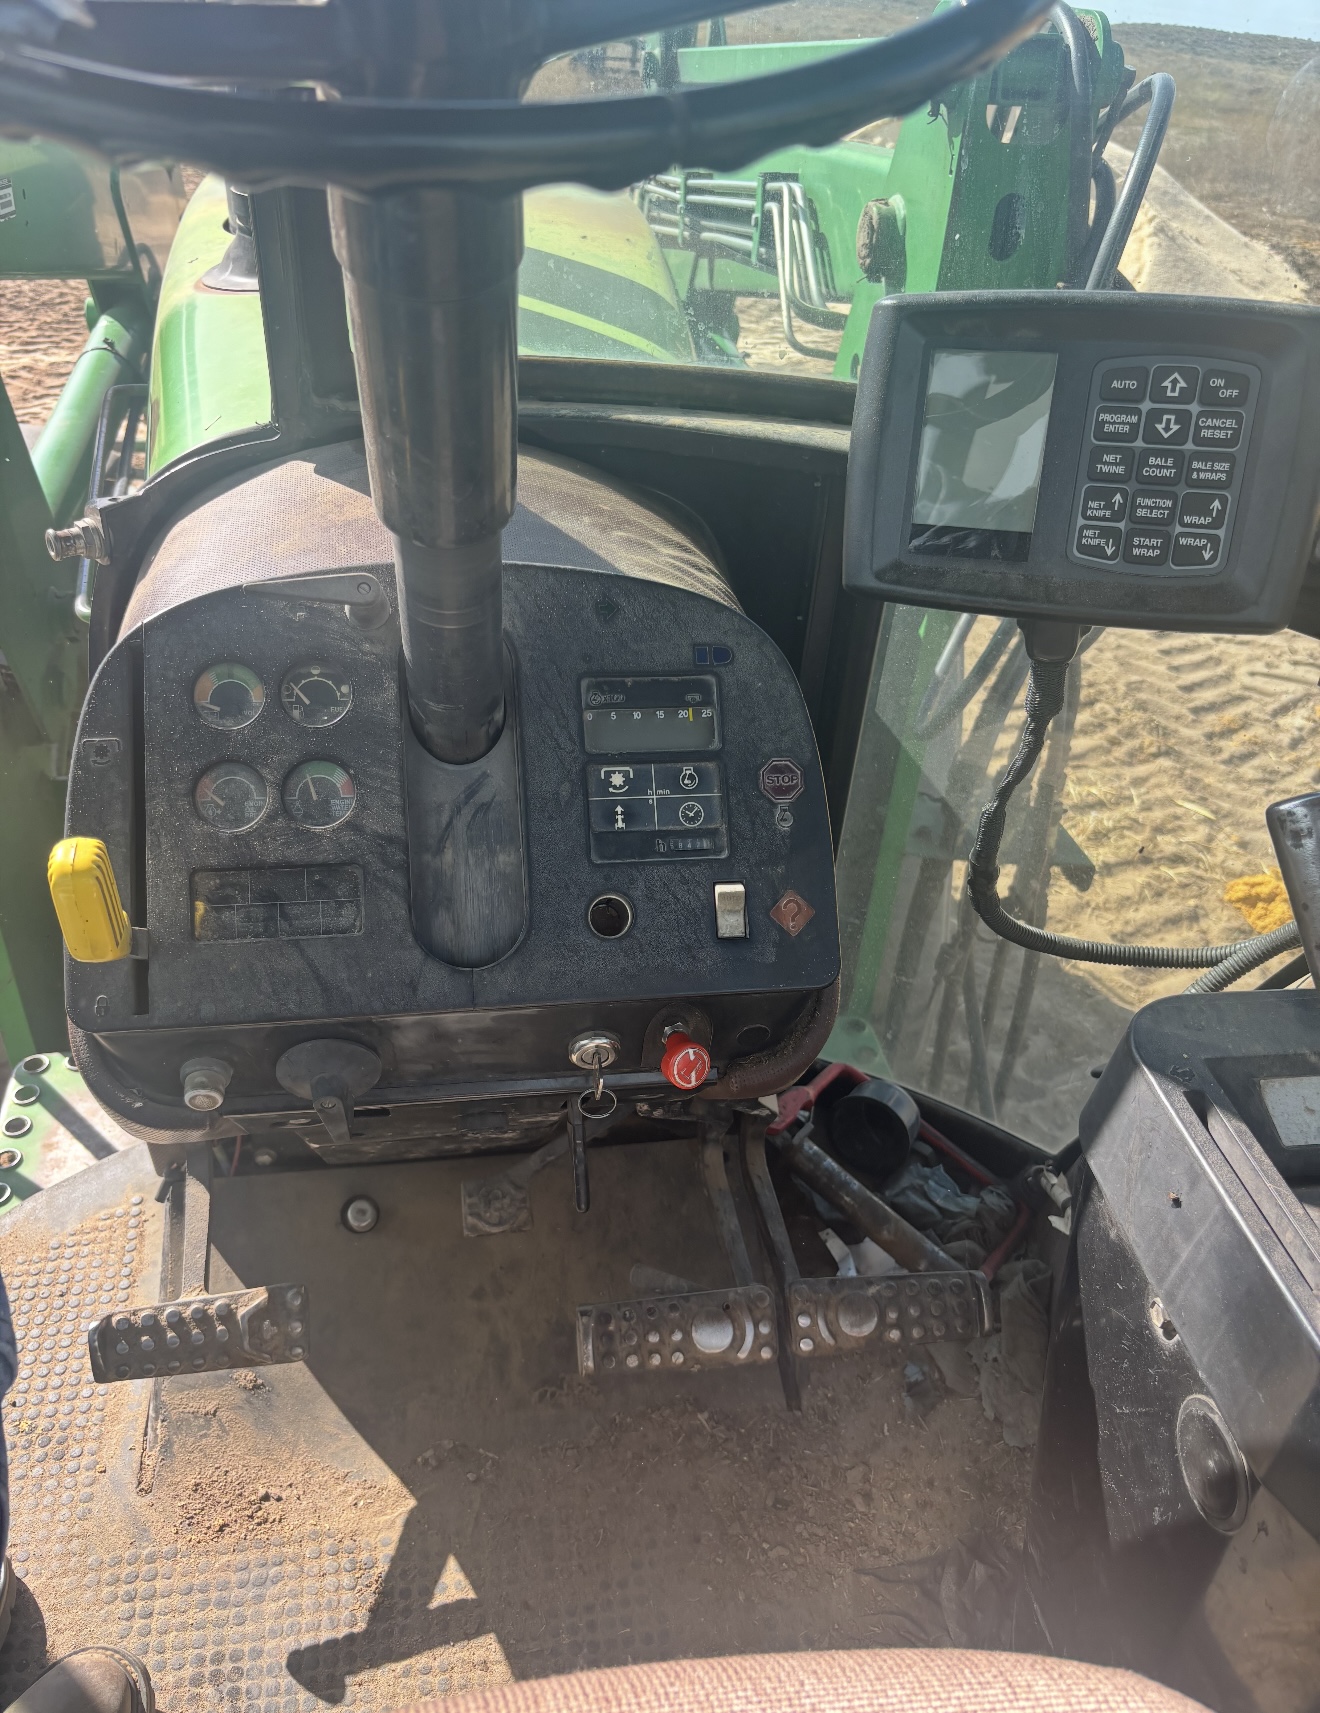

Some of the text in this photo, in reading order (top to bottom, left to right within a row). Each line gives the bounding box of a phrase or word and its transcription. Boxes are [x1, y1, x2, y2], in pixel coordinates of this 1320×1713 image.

[1111, 380, 1137, 389] AUTO
[1210, 378, 1224, 387] ON
[1219, 390, 1239, 398] OFF
[1099, 414, 1137, 423] PROGRAM
[1199, 418, 1238, 428] CANCEL
[1104, 425, 1129, 433] ENTER
[1201, 430, 1232, 439] RESET
[1103, 454, 1121, 463] NET
[1149, 457, 1174, 466] BALE
[1096, 465, 1125, 474] TWINE
[1192, 462, 1212, 470] BALE
[1143, 468, 1176, 477] COUNT
[1199, 472, 1226, 481] WRAPS
[1137, 498, 1172, 507] FUNCTION
[1136, 509, 1169, 518] SELECT
[1184, 516, 1211, 524] WRAP
[1082, 538, 1106, 546] KNIFE
[1133, 538, 1163, 547] START
[1179, 537, 1207, 546] WRAP
[1132, 549, 1160, 557] WRAP
[611, 712, 616, 720] 5
[633, 711, 641, 719] 10
[678, 710, 688, 718] 20
[702, 709, 712, 717] 25
[766, 775, 798, 785] STOP
